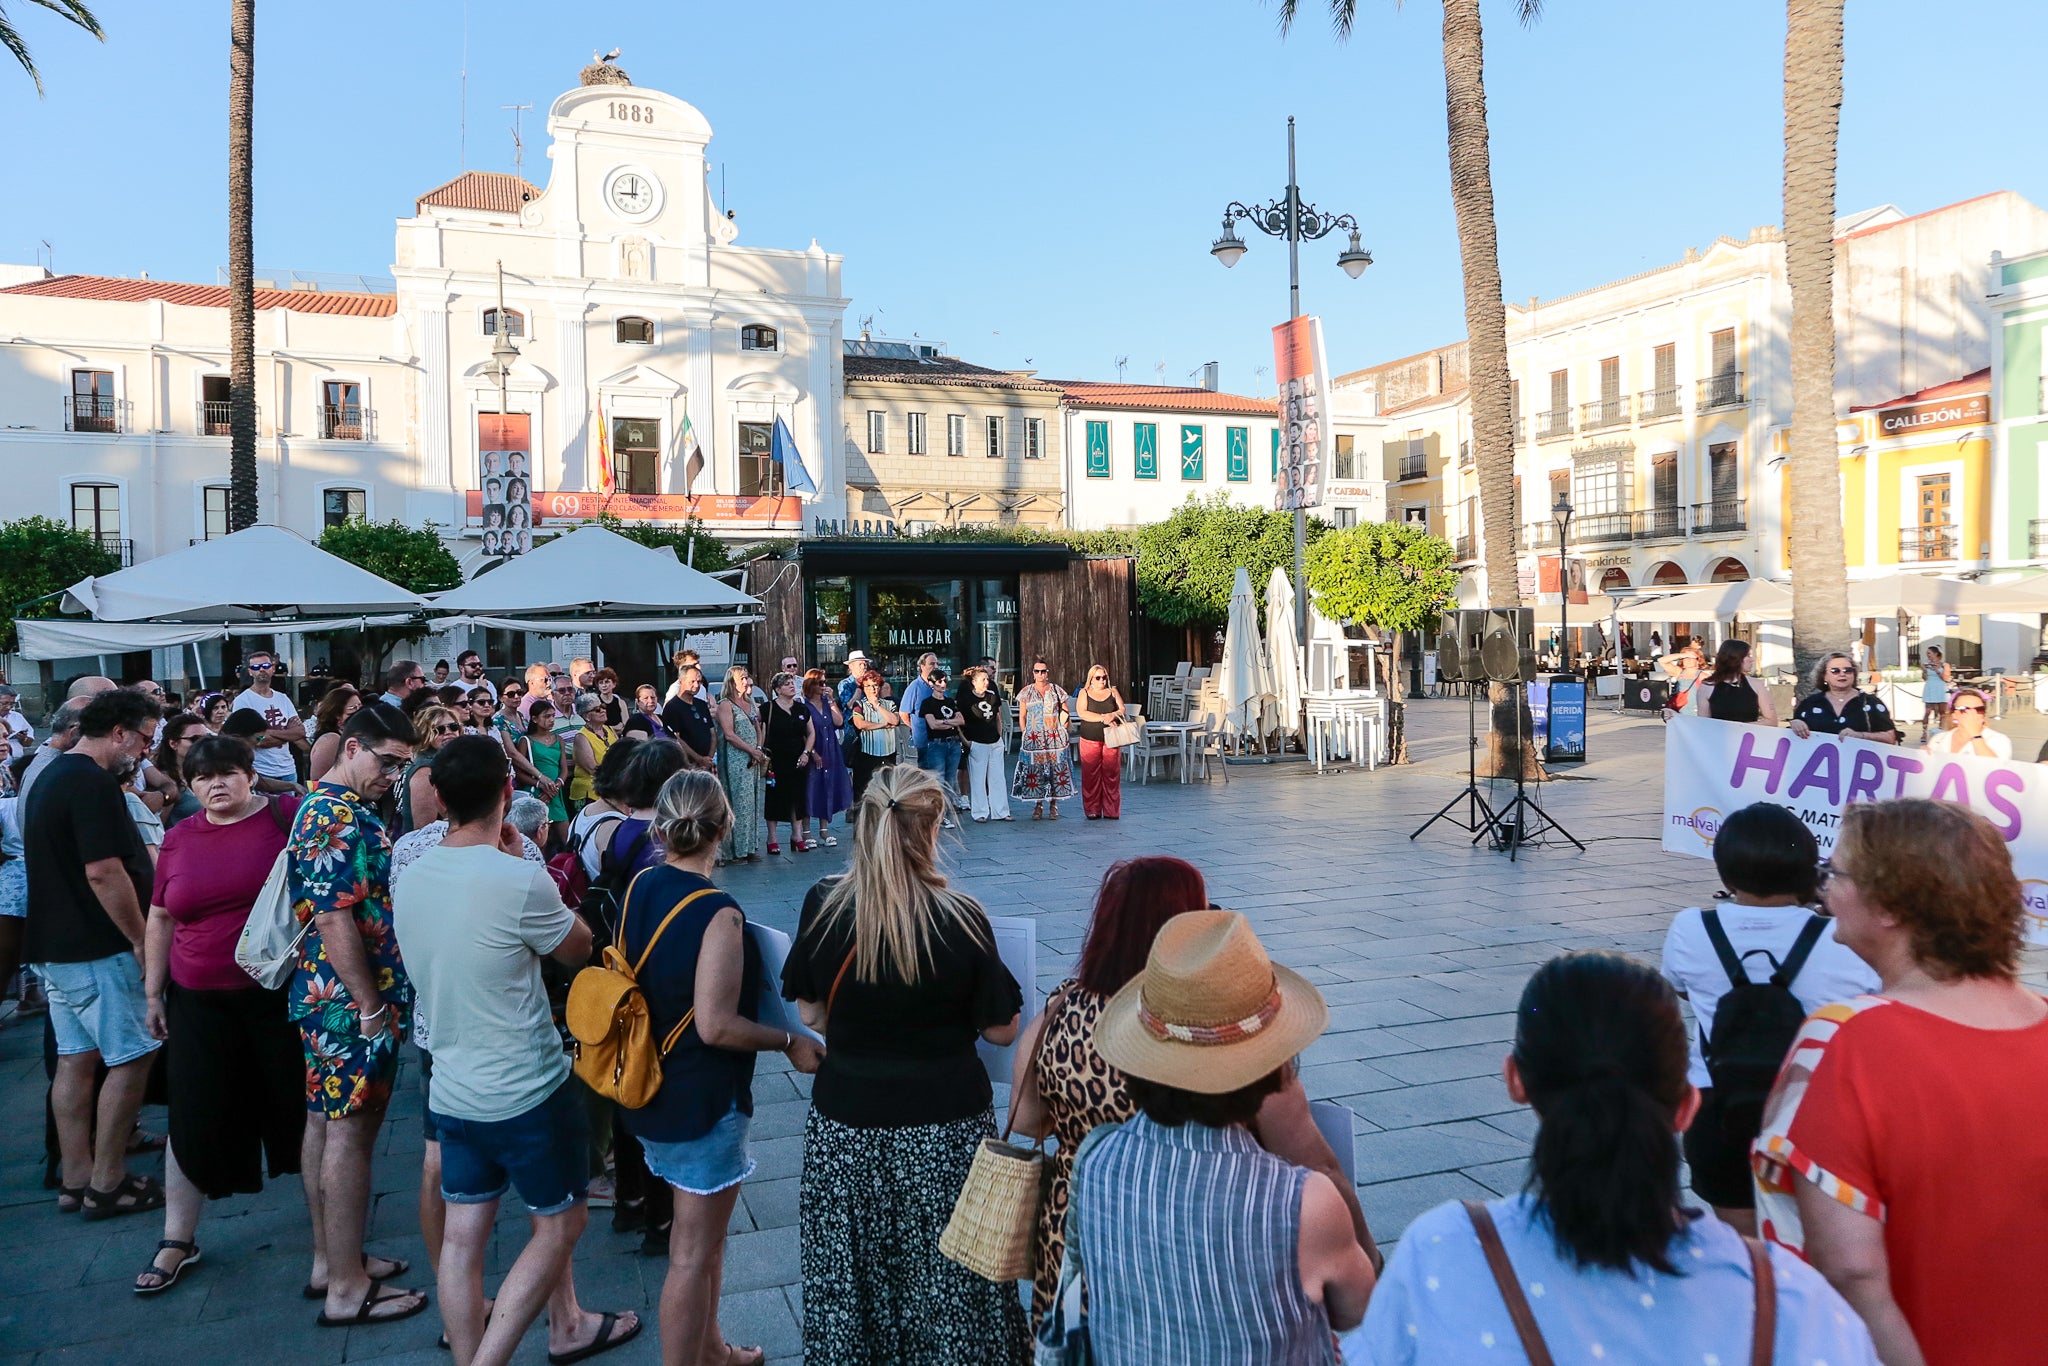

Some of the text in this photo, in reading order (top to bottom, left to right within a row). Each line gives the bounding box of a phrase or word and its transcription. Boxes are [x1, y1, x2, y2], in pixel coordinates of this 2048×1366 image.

[608, 102, 654, 124] 1883
[1884, 408, 1961, 430] CALLEJÓN
[551, 495, 579, 516] 69
[581, 496, 668, 505] FESTIVAL INTERNACIONAL
[815, 519, 895, 537] MALABAR
[996, 600, 1018, 613] MAL
[889, 629, 951, 645] MALABAR
[1730, 732, 2025, 842] HARTAS
[1801, 809, 1844, 827] MAT
